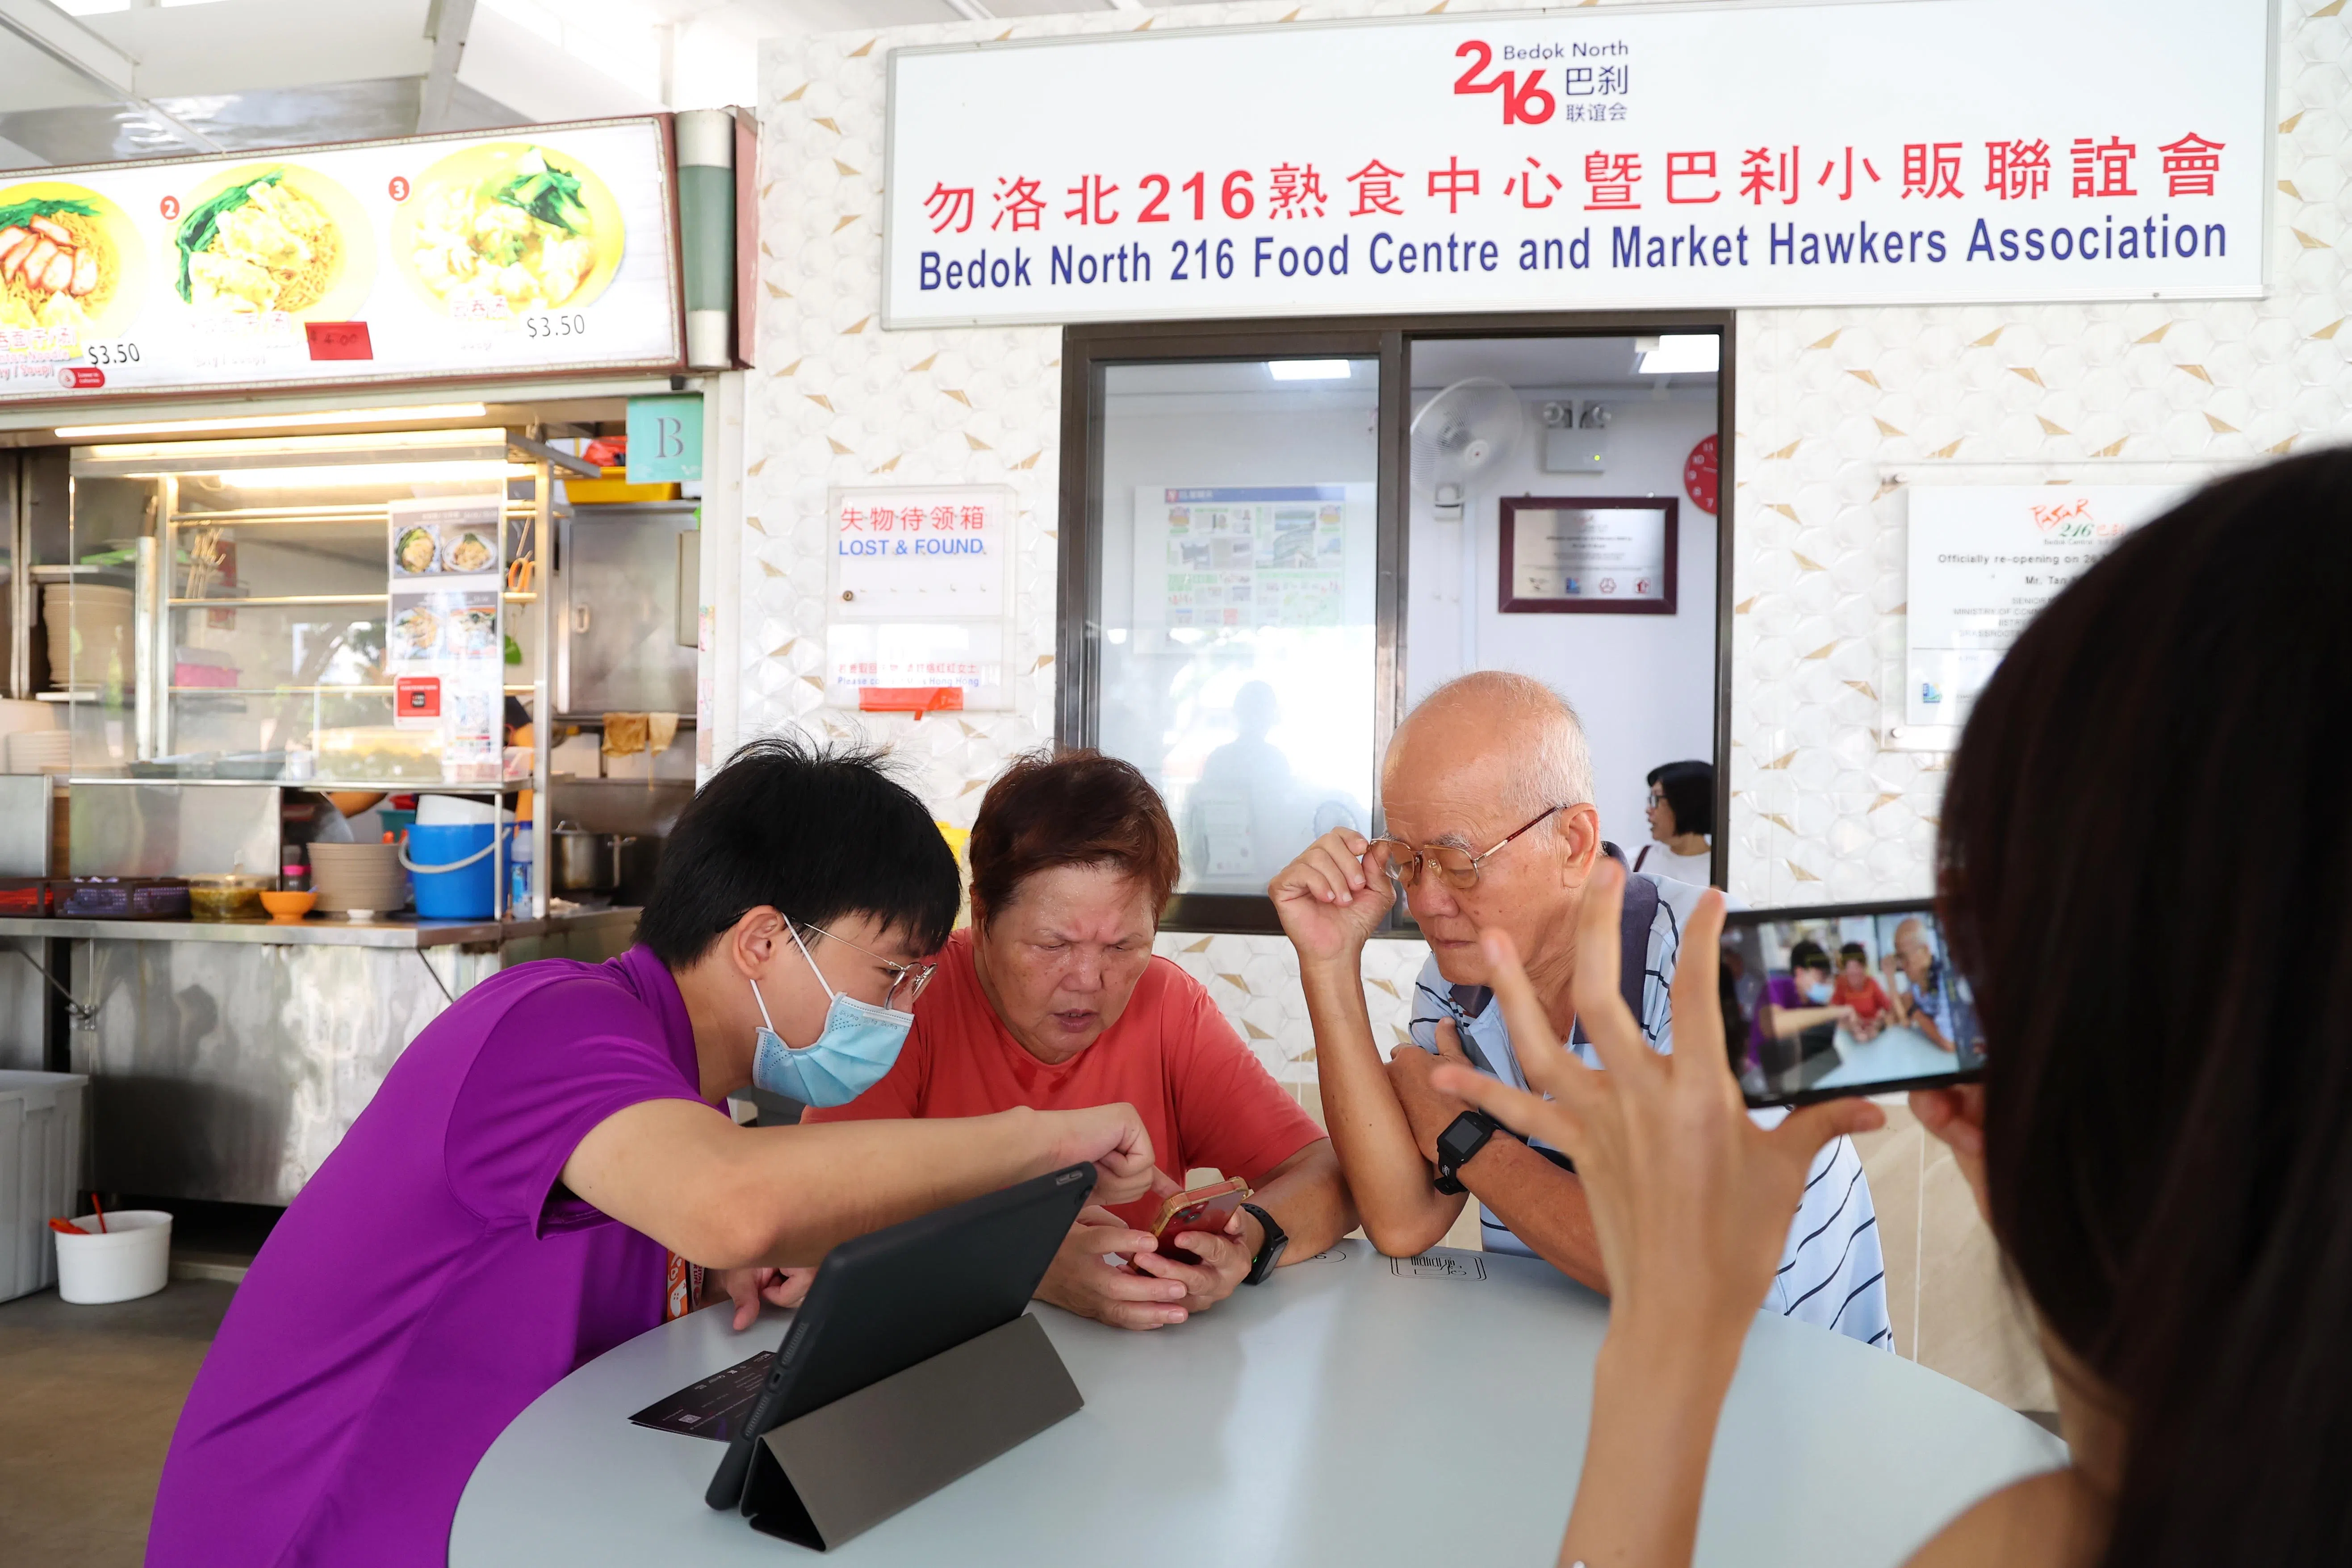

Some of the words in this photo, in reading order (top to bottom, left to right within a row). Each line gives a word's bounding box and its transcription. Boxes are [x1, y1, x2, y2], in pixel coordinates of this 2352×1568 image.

[1504, 43, 1564, 60] Bedok
[1573, 40, 1629, 57] North
[1454, 40, 1556, 125] 216
[1566, 64, 1628, 95] 巴刹
[1566, 102, 1628, 122] 联谊会
[394, 180, 405, 199] 3
[164, 200, 176, 217] 2
[921, 247, 1032, 290] Bedok
[1051, 242, 1151, 285] North
[1171, 238, 1235, 280] 216
[1255, 234, 1349, 277] Food
[1369, 231, 1499, 275] Centre
[1519, 229, 1590, 271] and
[1612, 224, 1749, 268] Market
[1770, 221, 1947, 265] Hawkers
[1967, 214, 2226, 262] Association
[527, 314, 585, 339] $3.50
[89, 343, 140, 368] $3.50
[654, 416, 685, 458] B
[840, 506, 985, 531] 失物待领箱
[2058, 523, 2095, 537] 216
[838, 539, 889, 556] LOST
[896, 541, 908, 555] &
[915, 539, 983, 555] FOUND
[1938, 554, 1989, 564] Officially
[1994, 555, 2059, 565] re-opening
[2025, 576, 2042, 585] Mr.
[2048, 576, 2067, 585] Tan
[837, 676, 867, 685] Please
[929, 677, 953, 687] Hong
[956, 677, 979, 687] Hong
